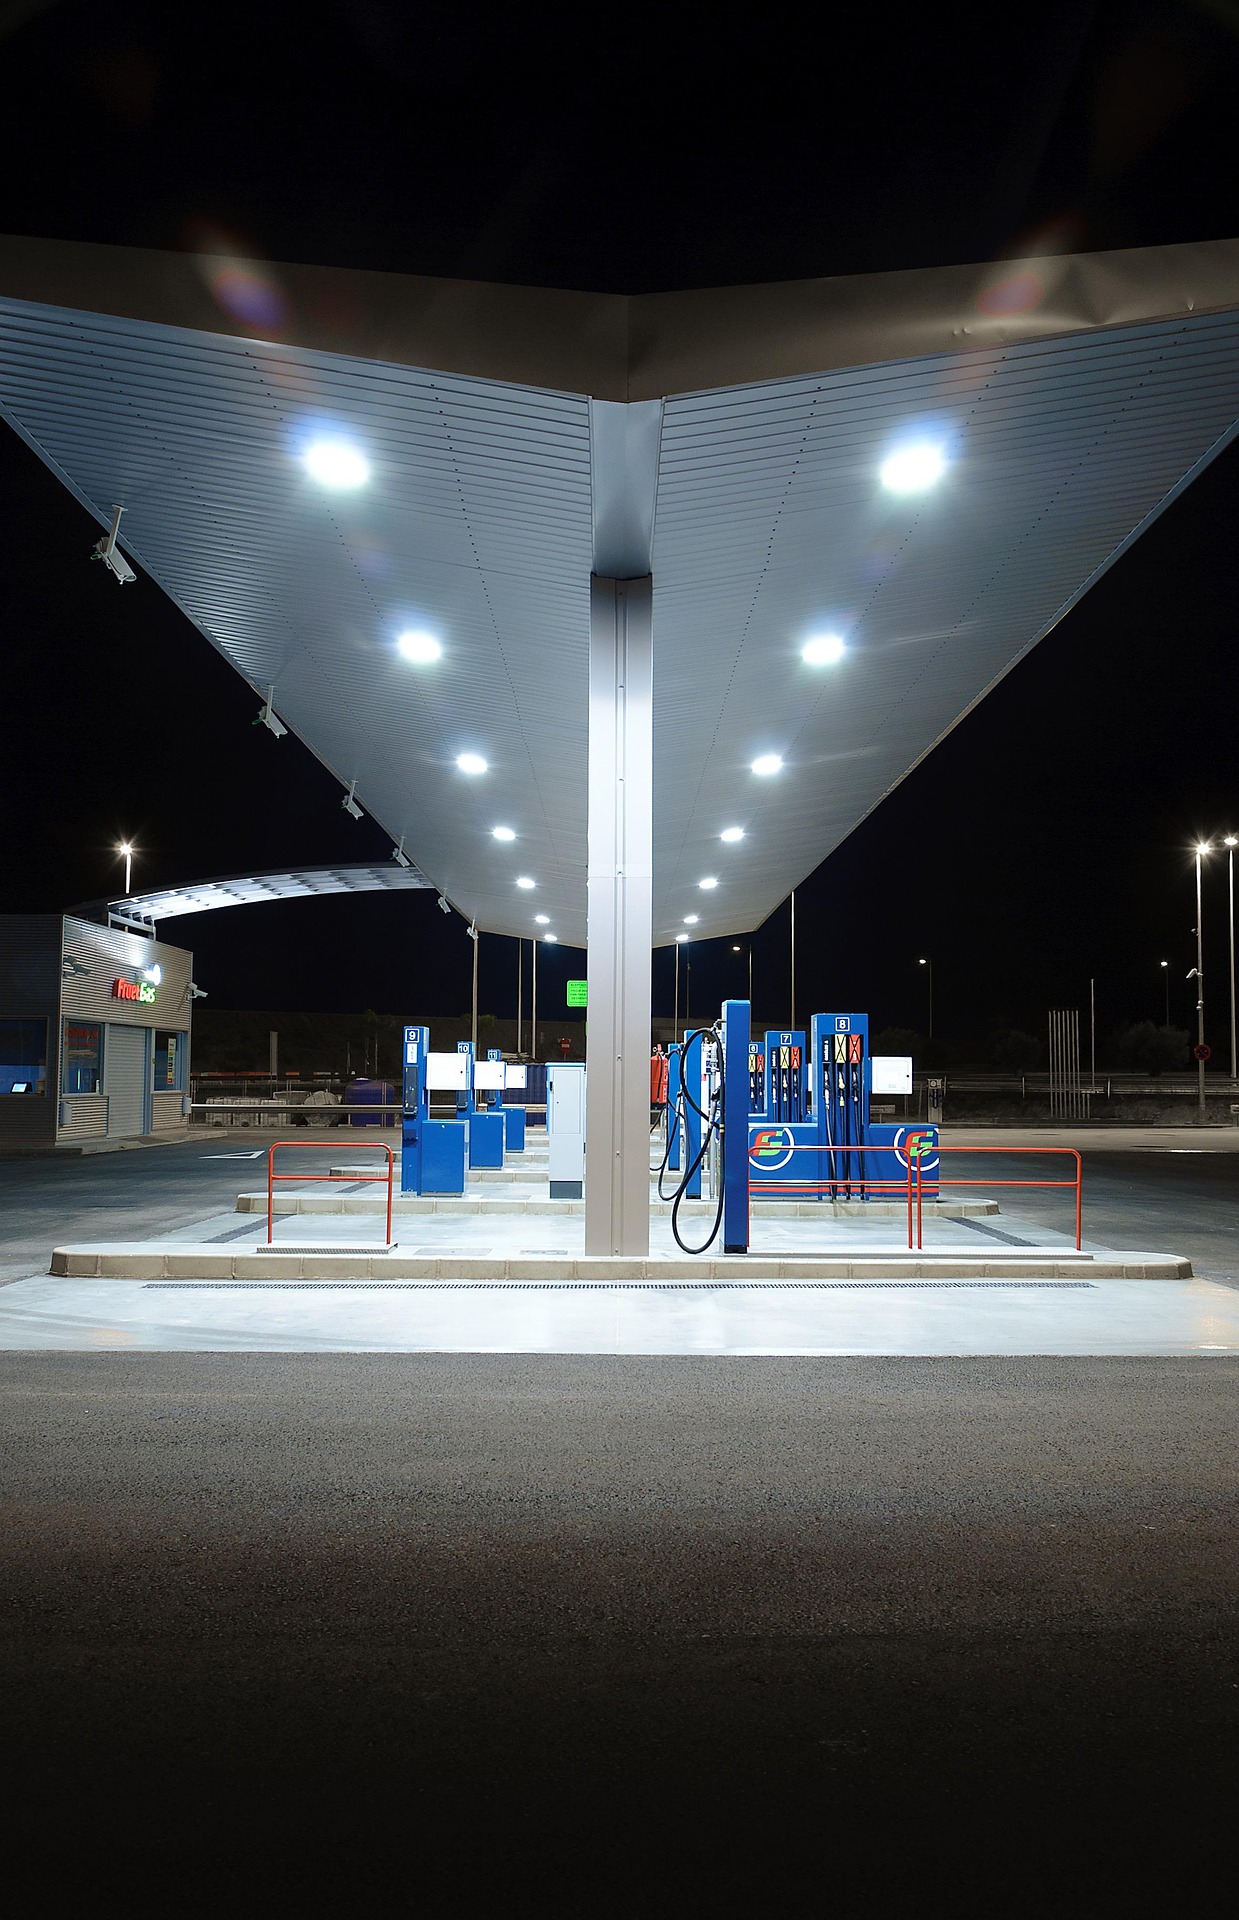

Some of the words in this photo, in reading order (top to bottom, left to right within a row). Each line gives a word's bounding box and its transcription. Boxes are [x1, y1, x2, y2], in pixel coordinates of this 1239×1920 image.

[839, 1020, 846, 1029] 8
[409, 1031, 416, 1040] 9
[459, 1045, 469, 1053] 10
